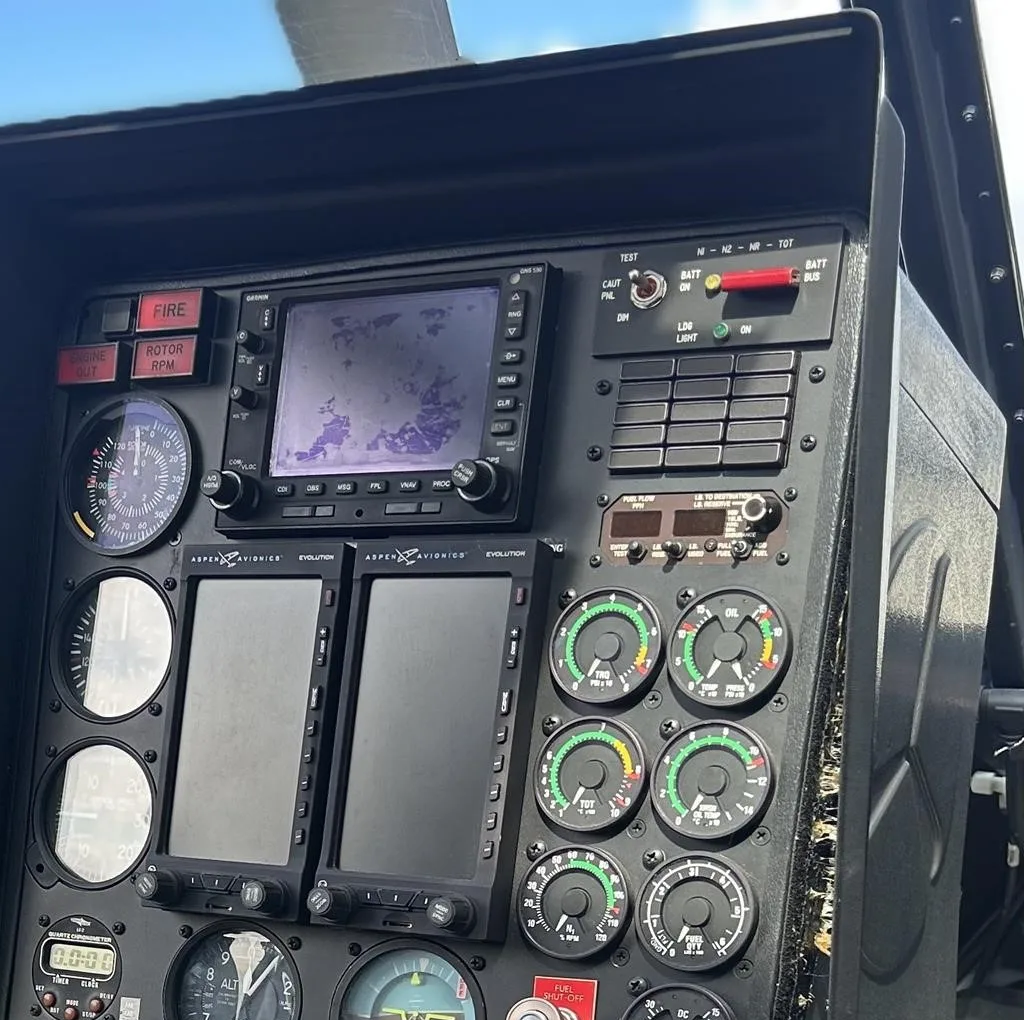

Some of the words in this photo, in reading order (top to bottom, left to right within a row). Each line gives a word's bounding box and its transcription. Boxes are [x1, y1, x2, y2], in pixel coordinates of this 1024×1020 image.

[722, 245, 732, 253] N2
[749, 242, 760, 251] NR
[778, 239, 794, 248] TOT
[620, 253, 638, 262] TEST
[805, 259, 827, 269] BATT
[681, 270, 701, 279] BATT
[804, 272, 820, 282] BUS
[602, 280, 621, 289] CAUT
[680, 283, 691, 292] ON
[601, 292, 615, 300] PNL
[153, 303, 187, 319] FIRE
[678, 322, 693, 331] LDG
[740, 325, 751, 334] ON
[676, 333, 698, 343] LIGHT
[146, 344, 183, 356] ROTOR
[70, 351, 106, 362] ENGINE
[152, 361, 175, 371] RPM
[77, 366, 97, 377] OUT
[497, 399, 511, 407] CLR
[725, 608, 738, 617] OIL
[595, 671, 609, 679] TRQ
[580, 800, 595, 809] TOT
[687, 942, 701, 950] QTY
[220, 979, 239, 989] ALT
[555, 984, 573, 993] FUEL
[544, 992, 584, 1002] SHUT-OFF
[677, 1010, 689, 1018] DC
